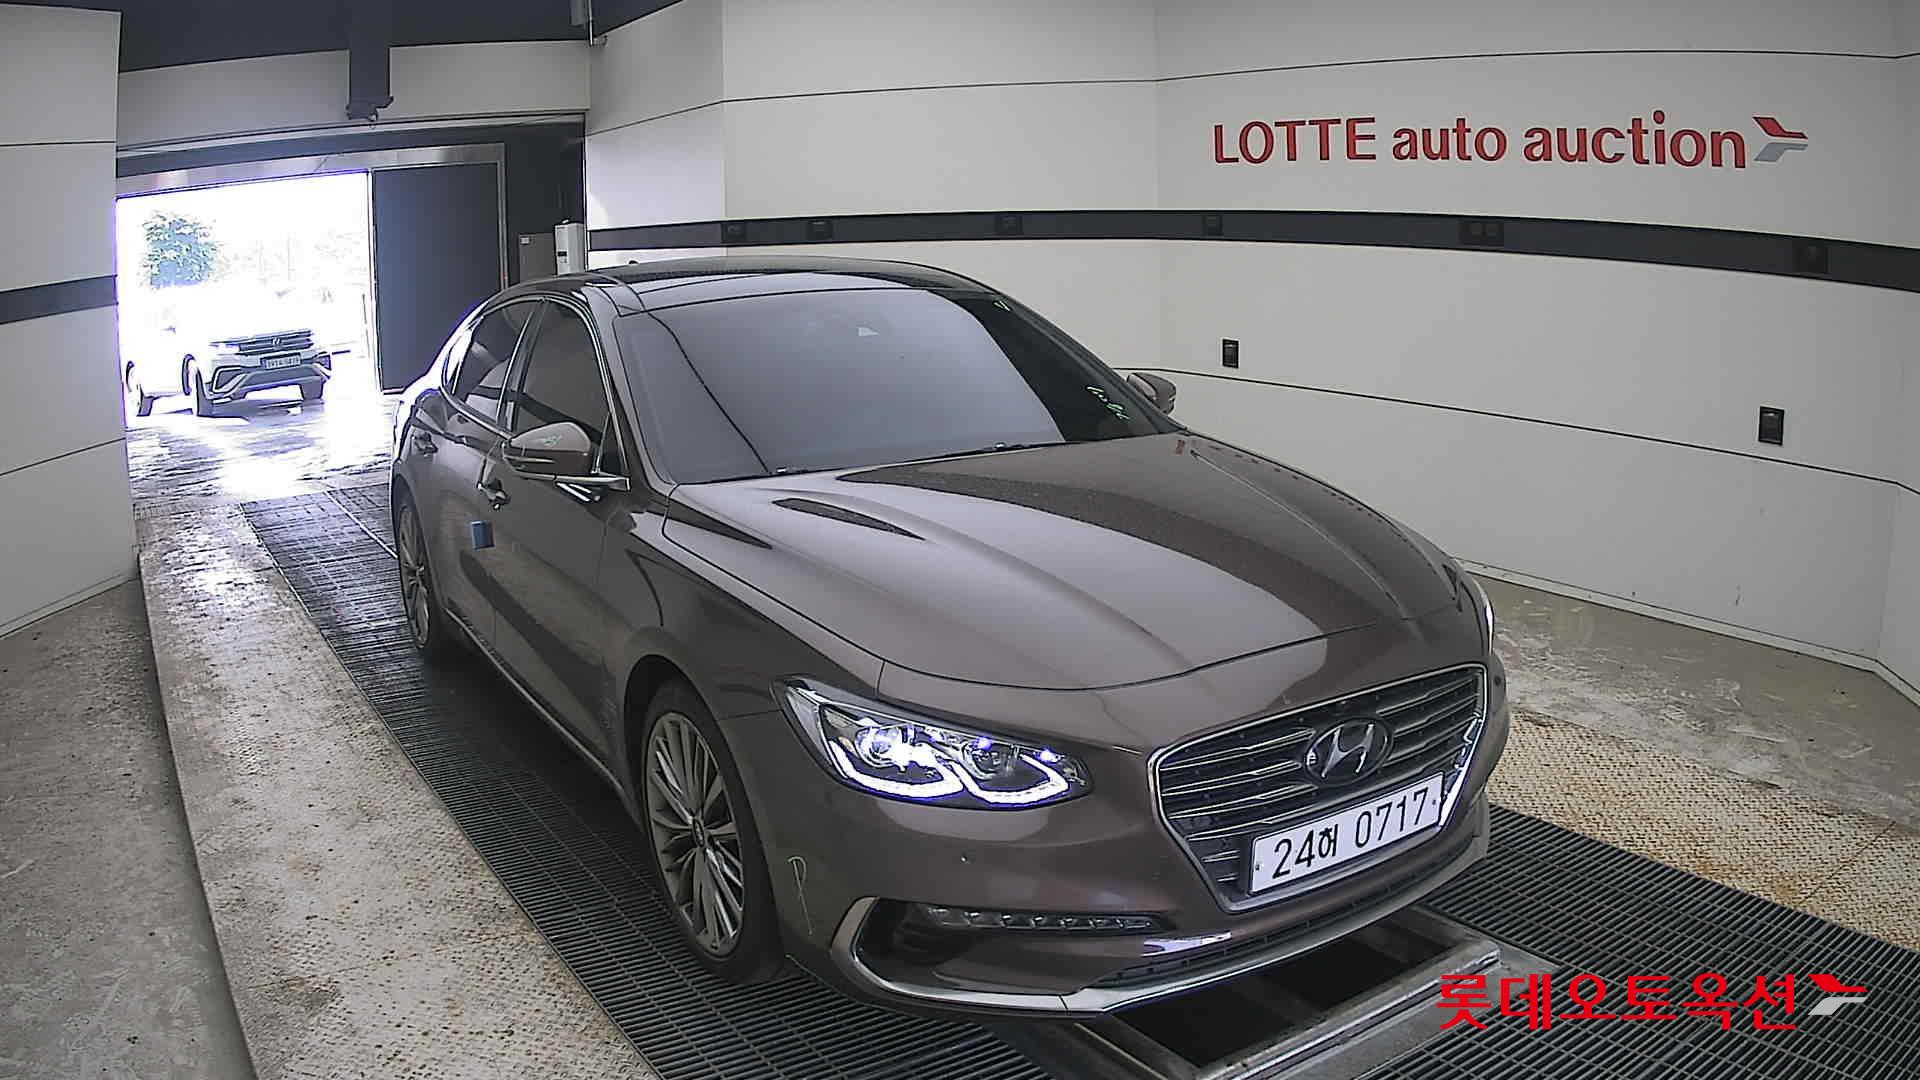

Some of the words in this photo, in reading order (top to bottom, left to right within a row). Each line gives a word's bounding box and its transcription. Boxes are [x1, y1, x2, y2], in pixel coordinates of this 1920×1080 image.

[1214, 117, 1377, 164] LOTTE
[1393, 117, 1508, 161] auto
[1523, 111, 1746, 168] auction
[1272, 824, 1339, 879] 24허
[1355, 787, 1429, 848] 0717
